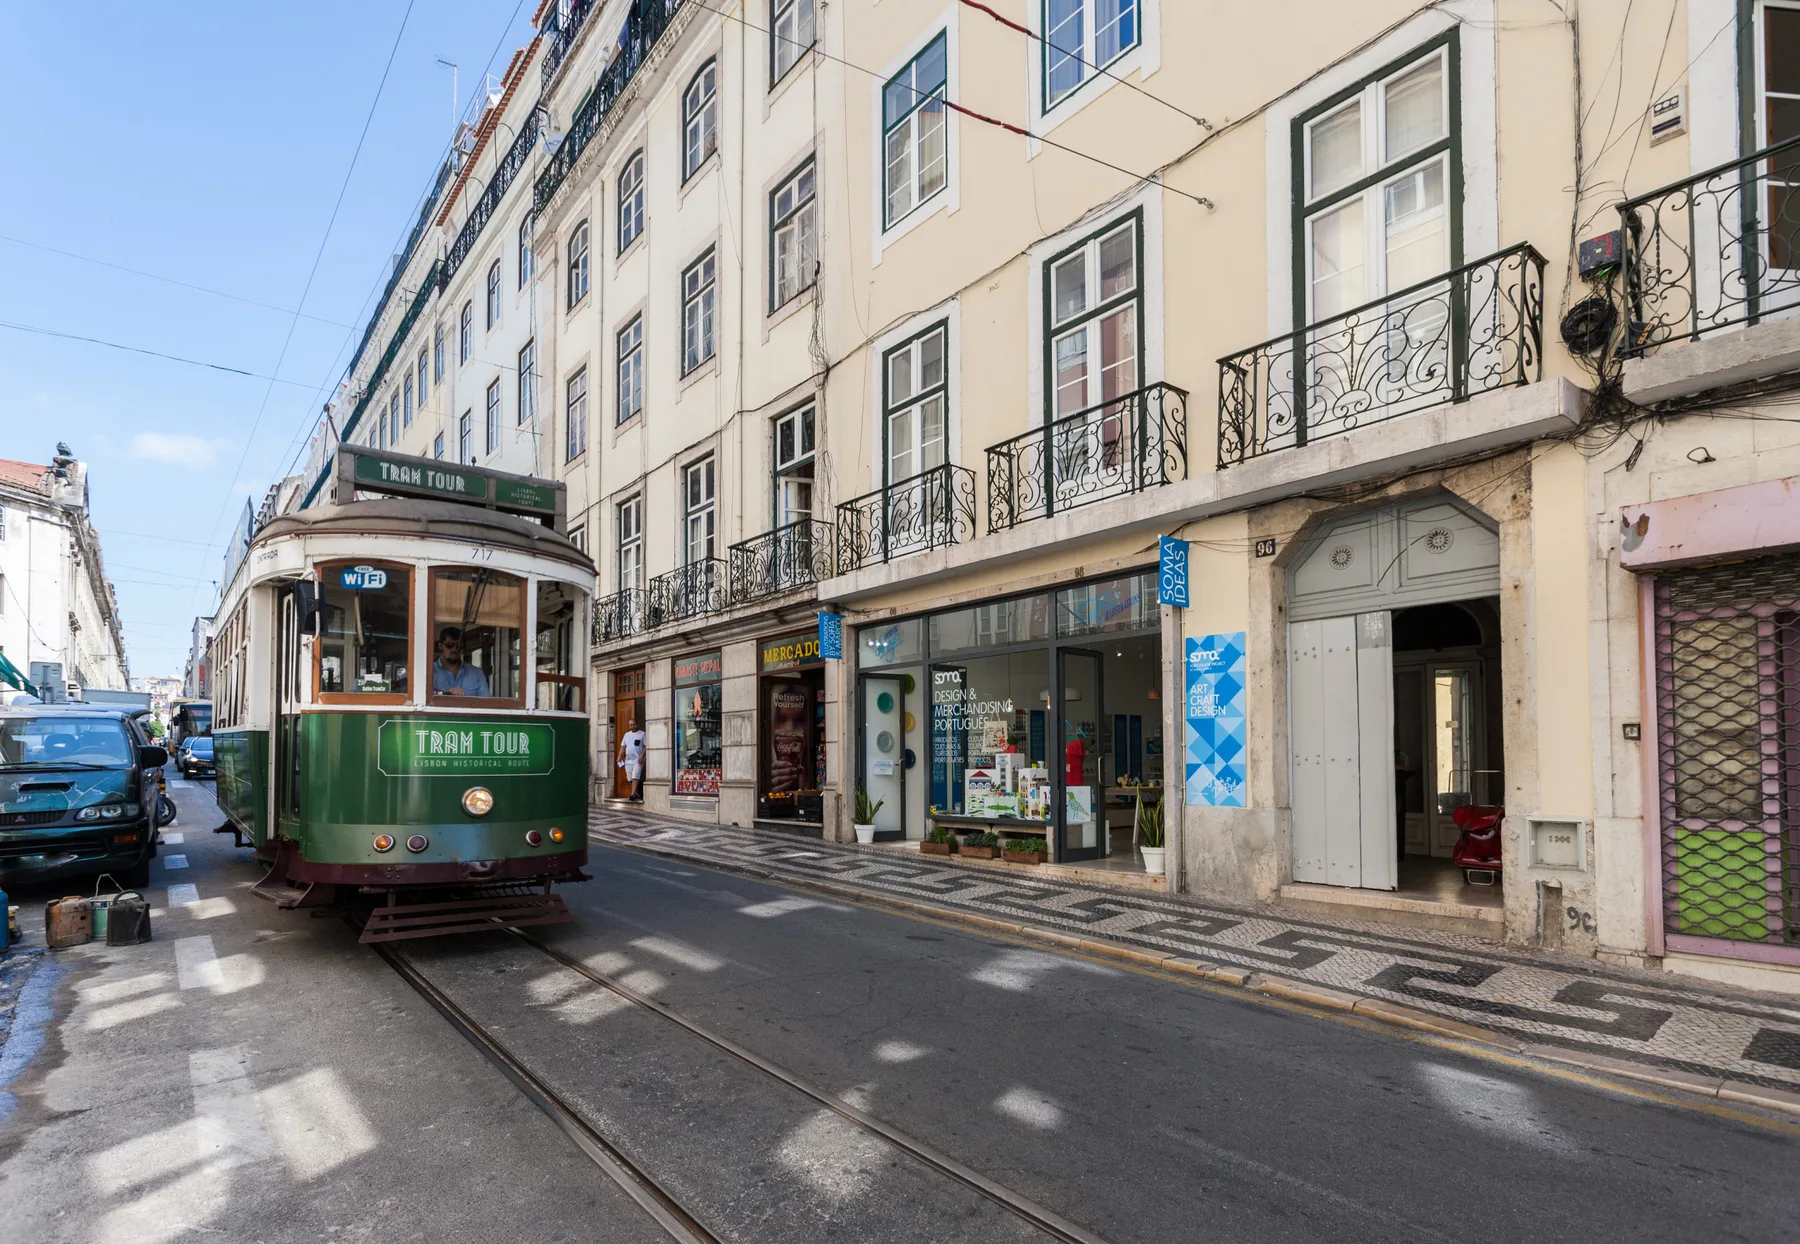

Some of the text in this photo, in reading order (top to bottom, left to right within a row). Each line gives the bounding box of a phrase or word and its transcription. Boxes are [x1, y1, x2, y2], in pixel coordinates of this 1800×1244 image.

[380, 462, 465, 493] TRAM TOUR
[472, 547, 493, 561] 717
[1258, 540, 1273, 556] 96
[1075, 567, 1084, 577] 98
[1163, 542, 1175, 601] SOMA
[1174, 550, 1186, 603] IDEAS
[763, 639, 820, 664] MERCADO
[829, 646, 836, 656] BY
[700, 658, 721, 675] NEPAL
[773, 692, 804, 702] Refresh
[934, 687, 977, 703] DESIGN &
[1190, 683, 1209, 695] ART
[774, 701, 804, 709] Yourself
[1190, 694, 1220, 706] CRAFT
[934, 700, 1014, 717] MERCHANDISING
[1190, 705, 1226, 718] DESIGN
[934, 714, 989, 731] PORTUGUÊS
[415, 730, 530, 754] TRAM TOUR
